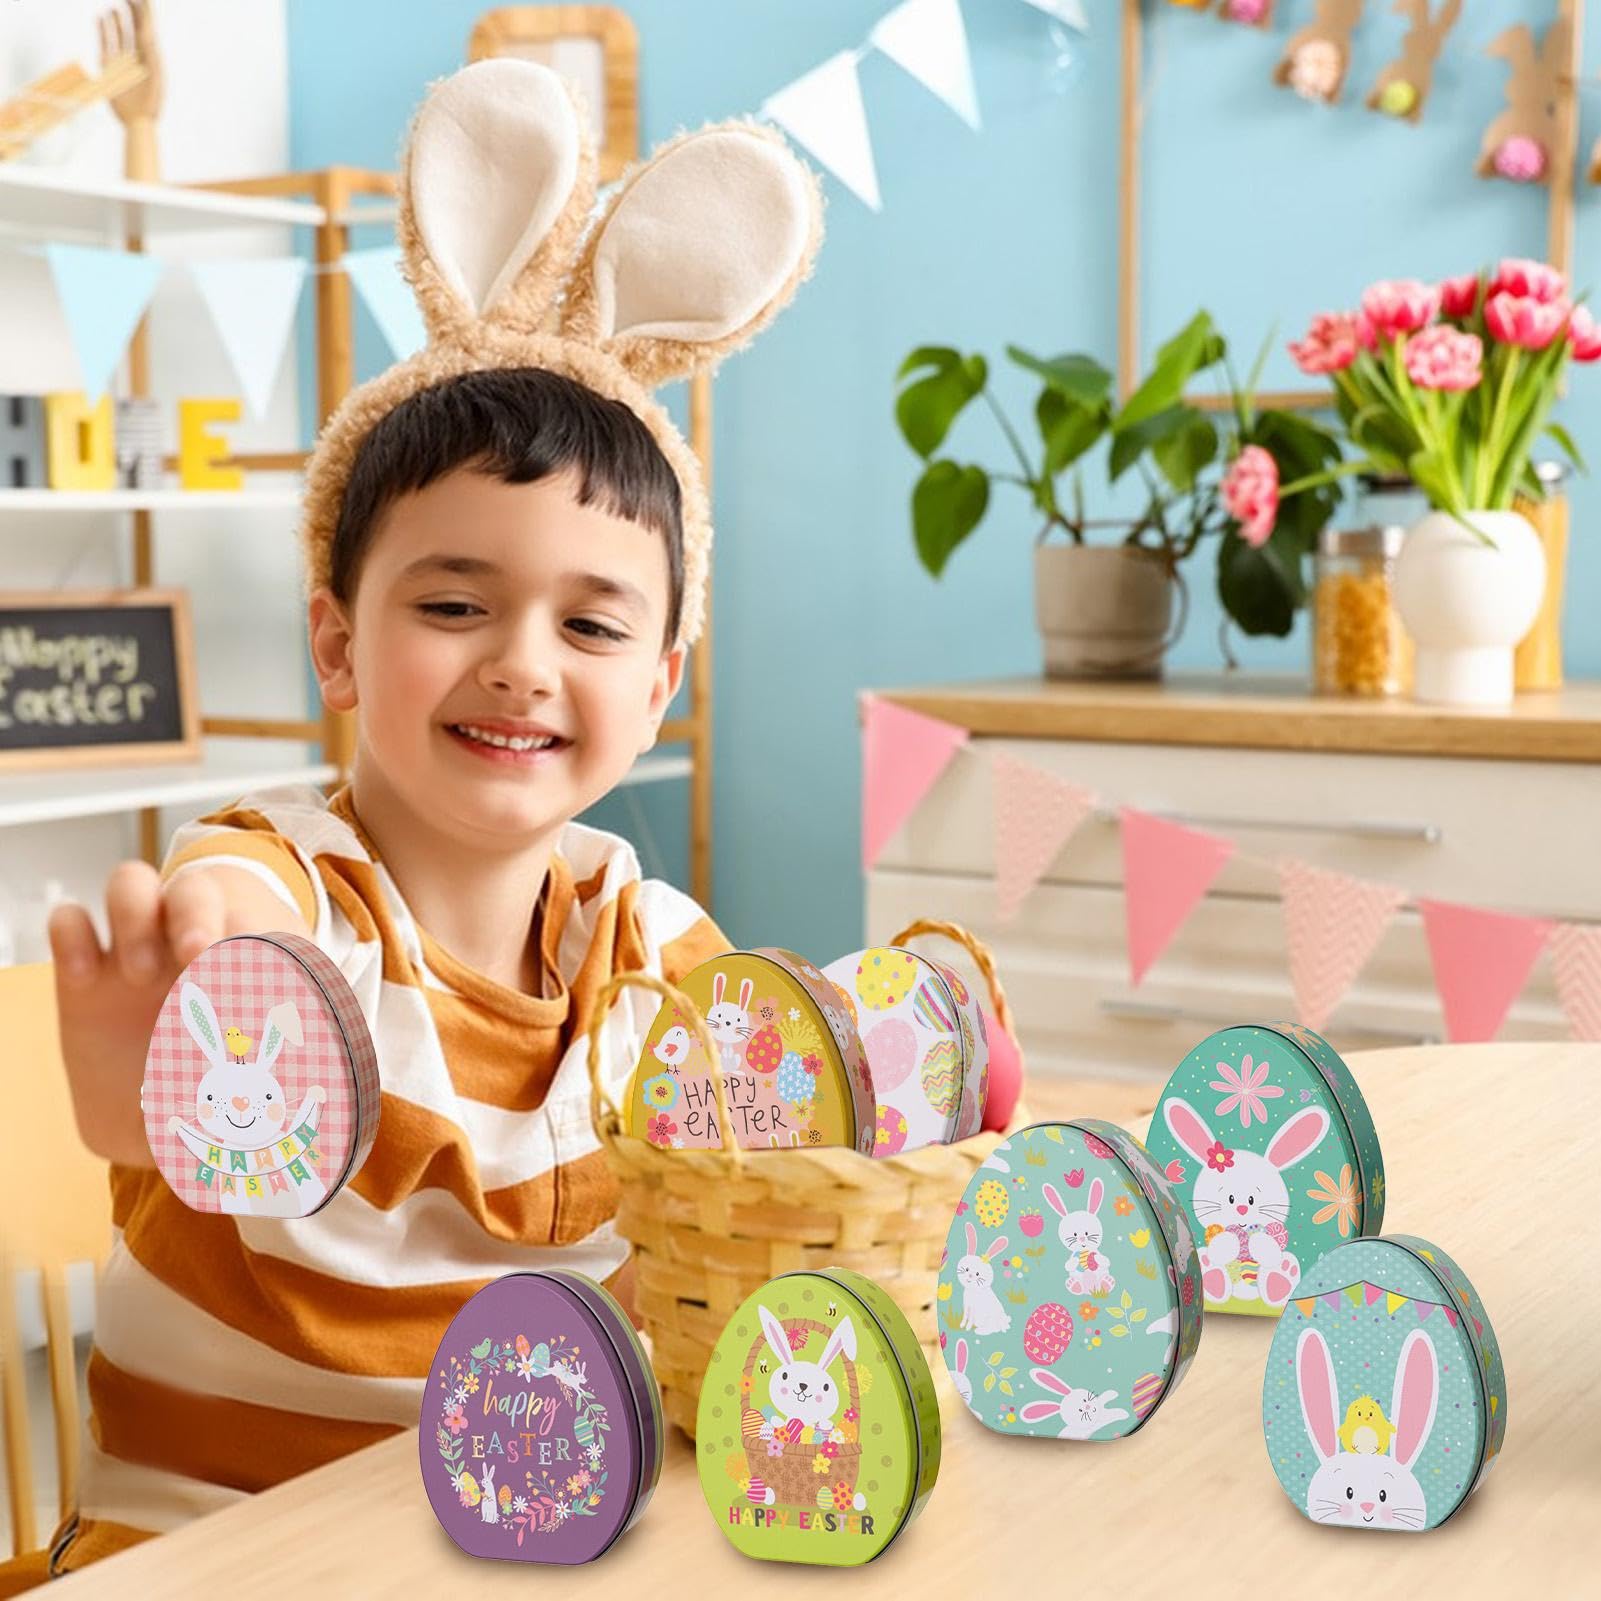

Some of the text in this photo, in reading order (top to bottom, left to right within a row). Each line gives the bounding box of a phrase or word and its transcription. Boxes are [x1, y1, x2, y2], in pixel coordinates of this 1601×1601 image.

[207, 1124, 315, 1166] HAPPY
[200, 1149, 320, 1191] EASTER
[482, 1378, 562, 1437] happy
[470, 1431, 572, 1466] EASTER
[729, 1506, 875, 1536] HAPPY EASTER
